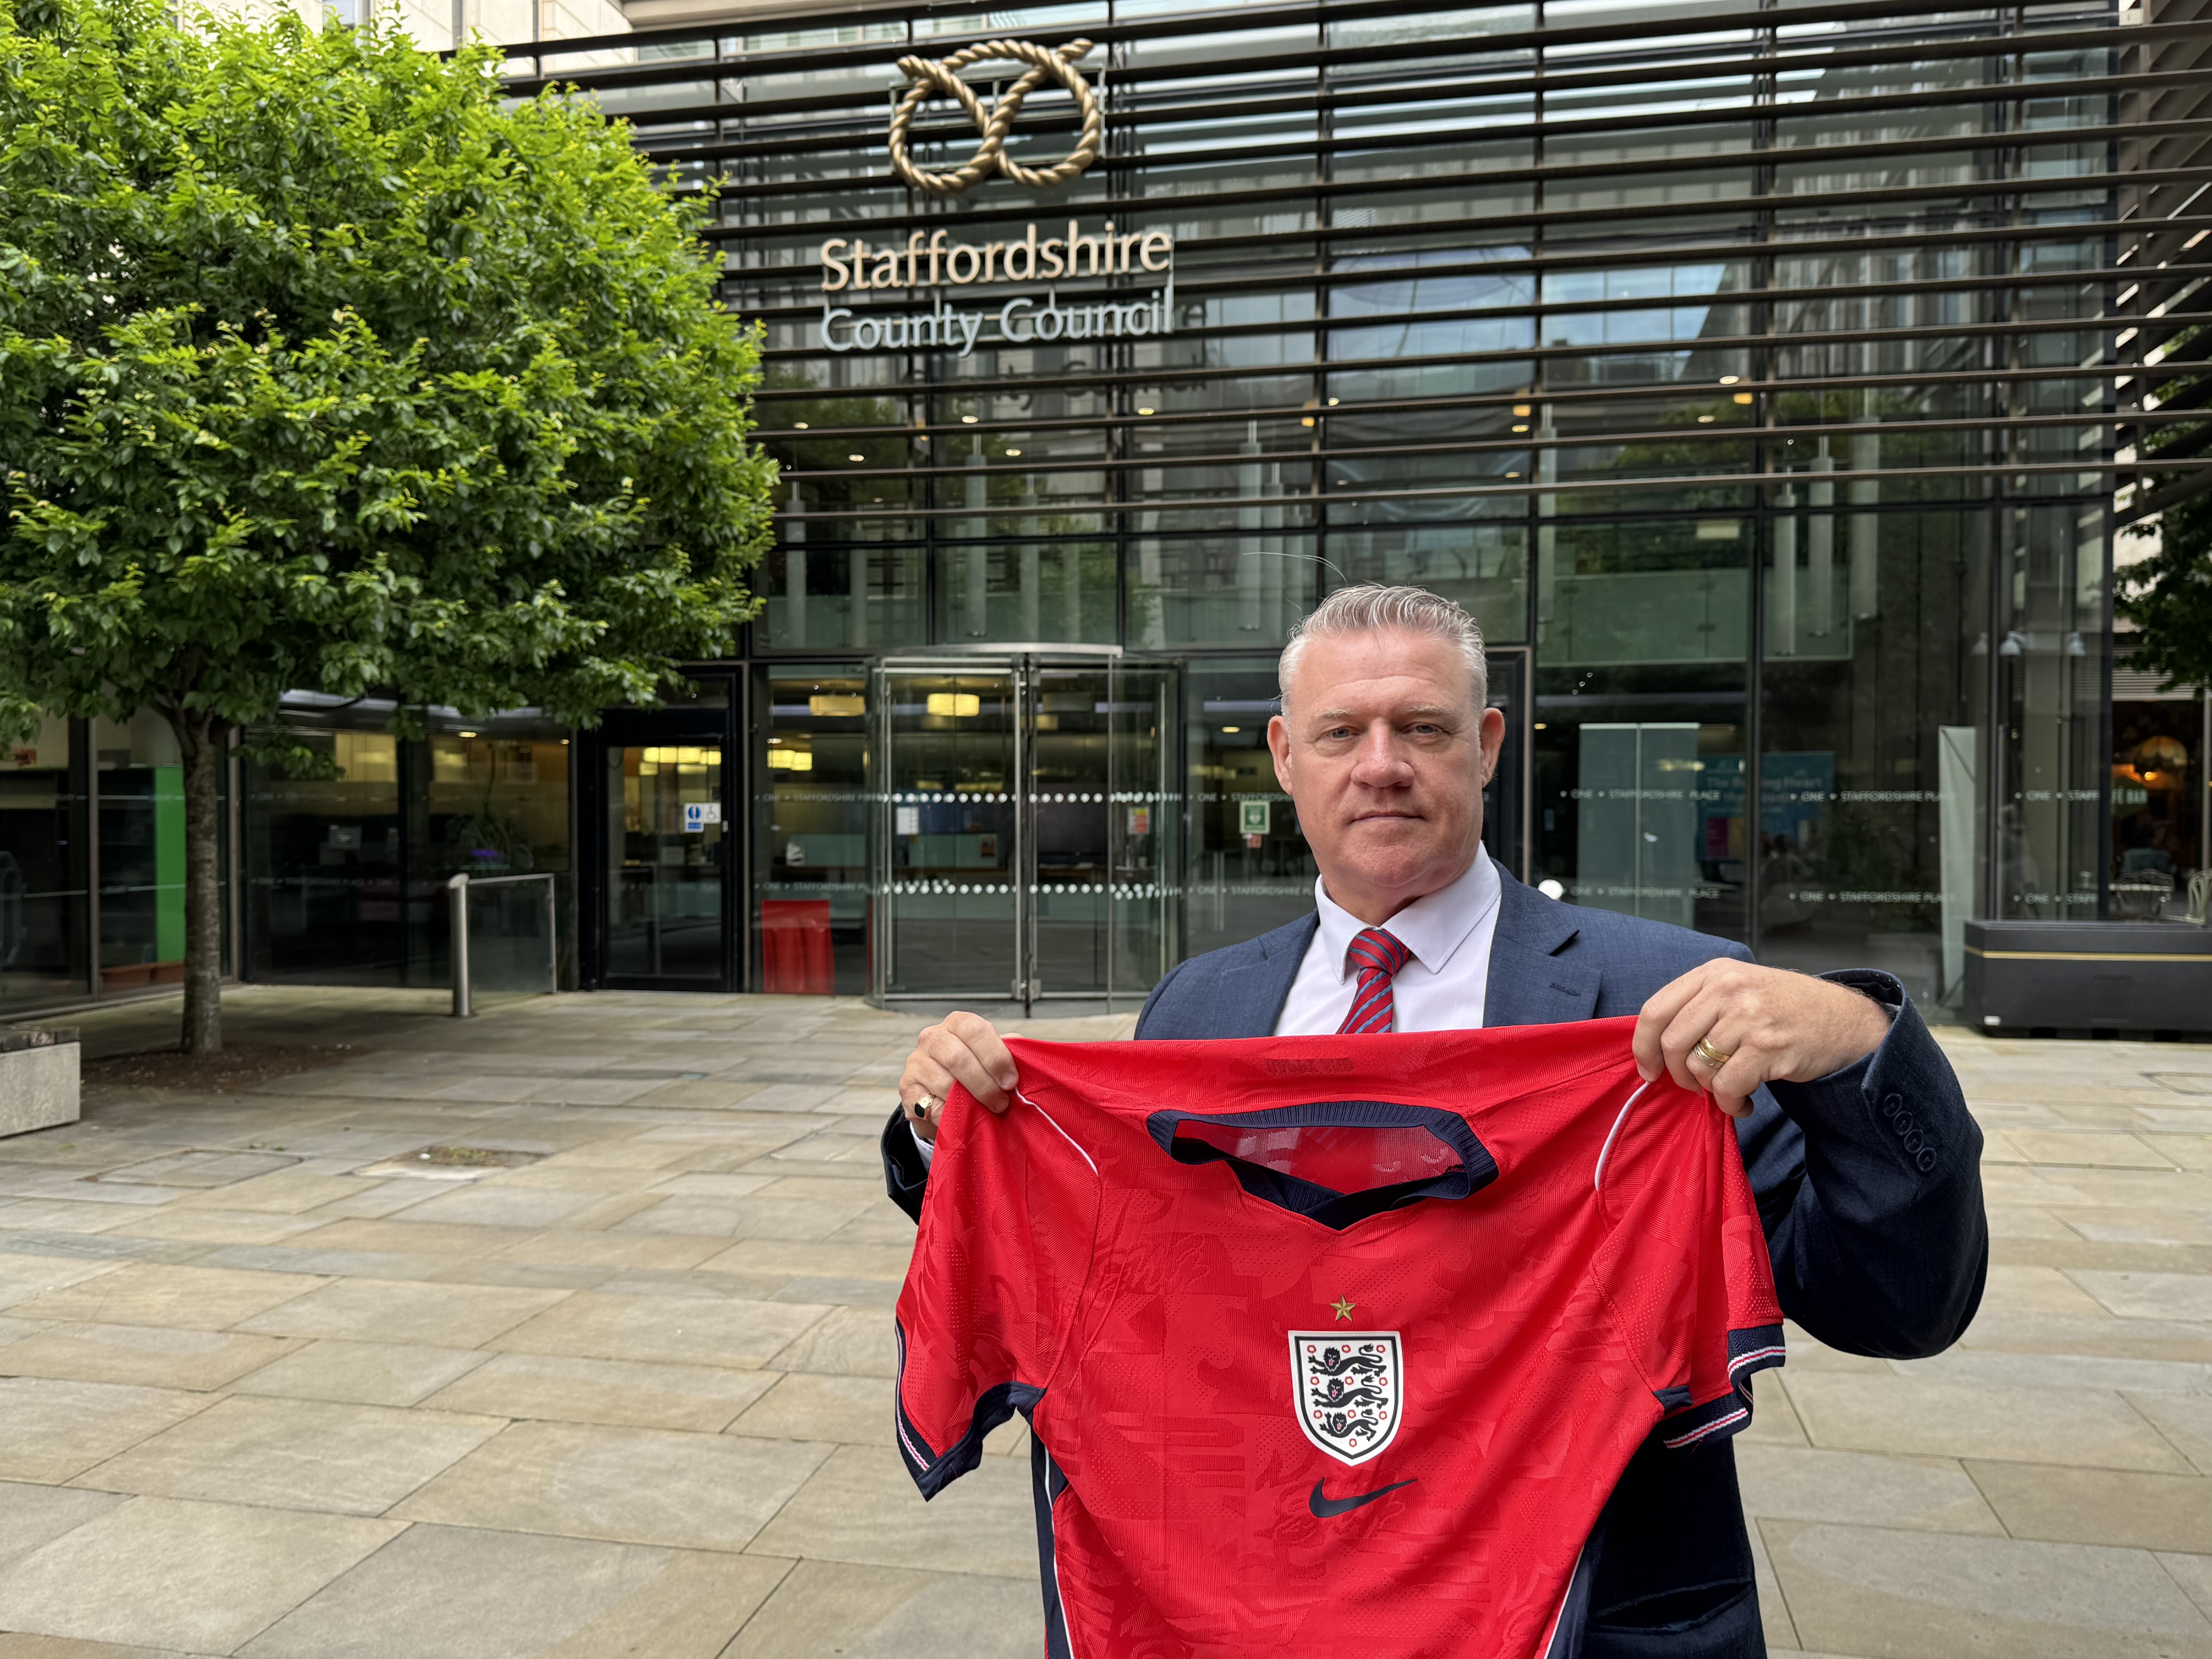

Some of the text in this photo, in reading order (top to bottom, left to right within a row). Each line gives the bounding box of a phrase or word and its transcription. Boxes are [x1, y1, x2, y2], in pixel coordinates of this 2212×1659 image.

[820, 219, 1172, 291] Staffordshire
[821, 304, 984, 357] County
[1000, 286, 1173, 343] Council
[1570, 788, 1593, 799] ONE
[1609, 789, 1683, 800] STAFFORDSHIRE
[1689, 789, 1720, 800] PLACE
[1800, 791, 1825, 802] ONE
[1840, 791, 1922, 802] STAFFORDSHIRE
[2026, 790, 2050, 801] ONE
[1570, 886, 1720, 898] ONE STAFFORDSHIRE PLACE
[1799, 891, 1824, 902] ONE
[1839, 891, 1922, 903] STAFFORDSHIRE
[2024, 893, 2049, 904] ONE
